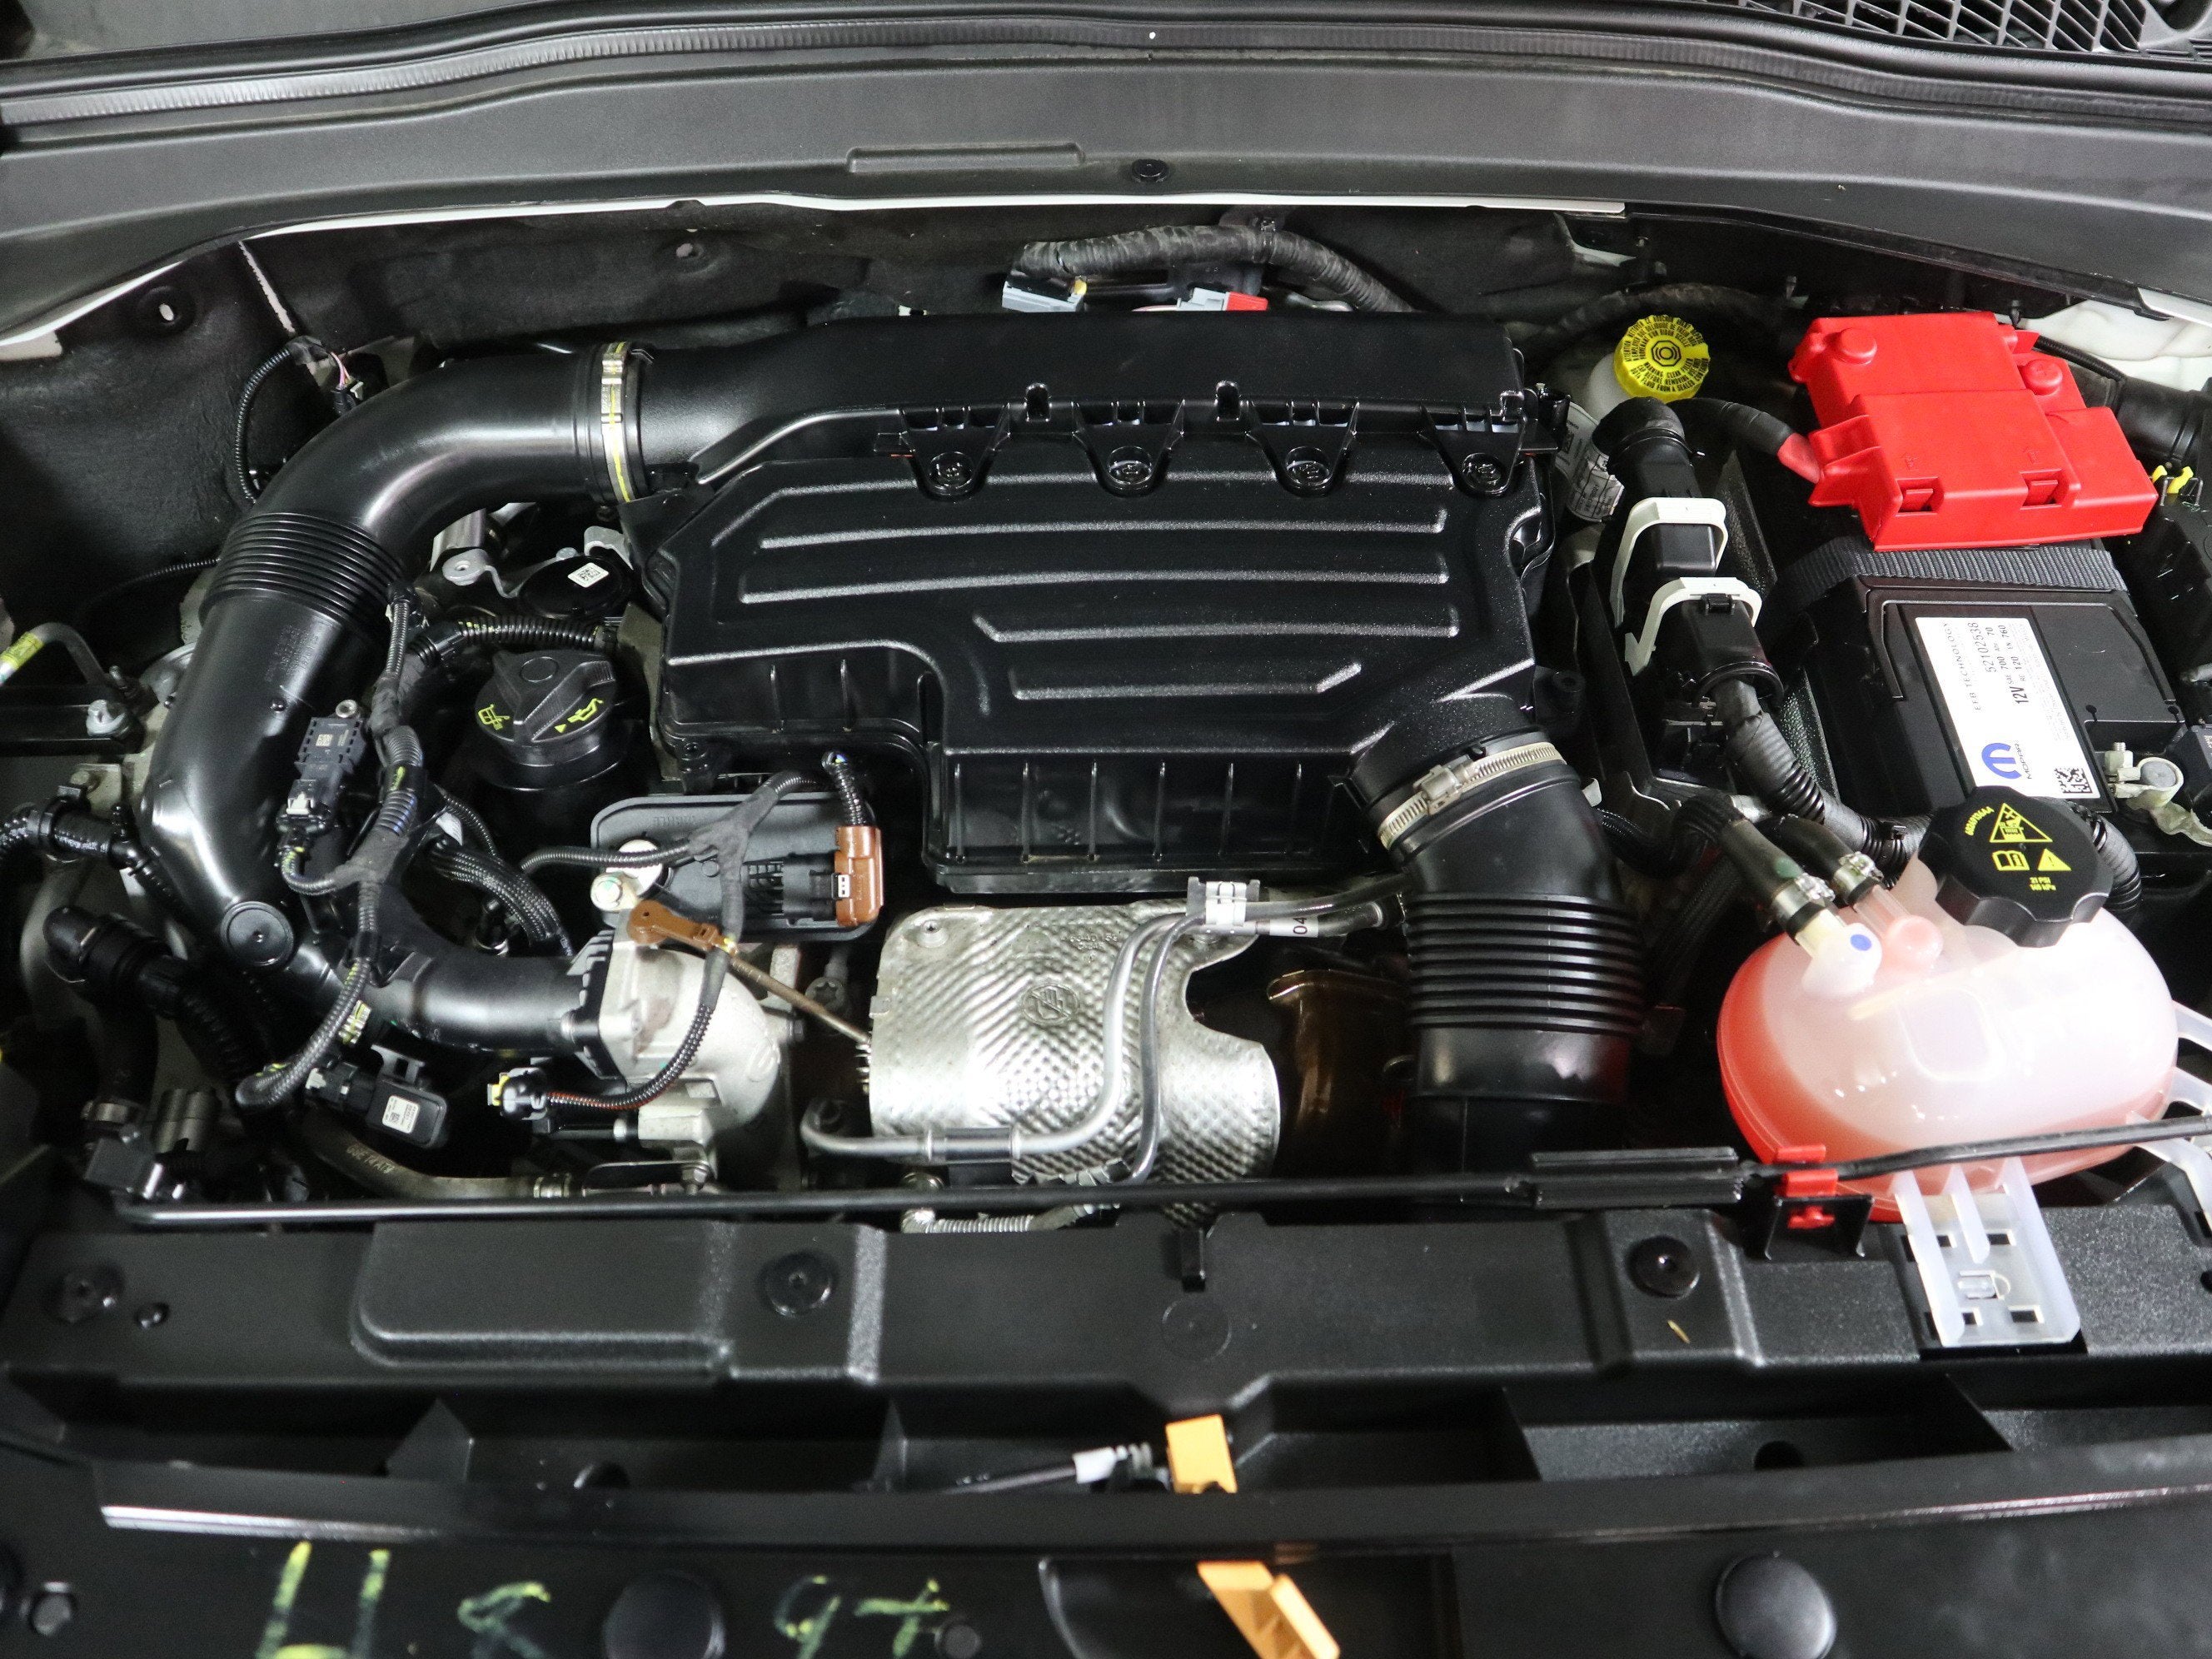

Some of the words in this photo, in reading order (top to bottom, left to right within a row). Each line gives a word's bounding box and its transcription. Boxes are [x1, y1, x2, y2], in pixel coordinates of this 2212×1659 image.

[1984, 626, 1995, 635] 70
[1996, 625, 2010, 638] 760
[1940, 621, 1974, 687] TECHNOLOGY
[2009, 655, 2023, 670] 120
[2008, 685, 2030, 704] 12V
